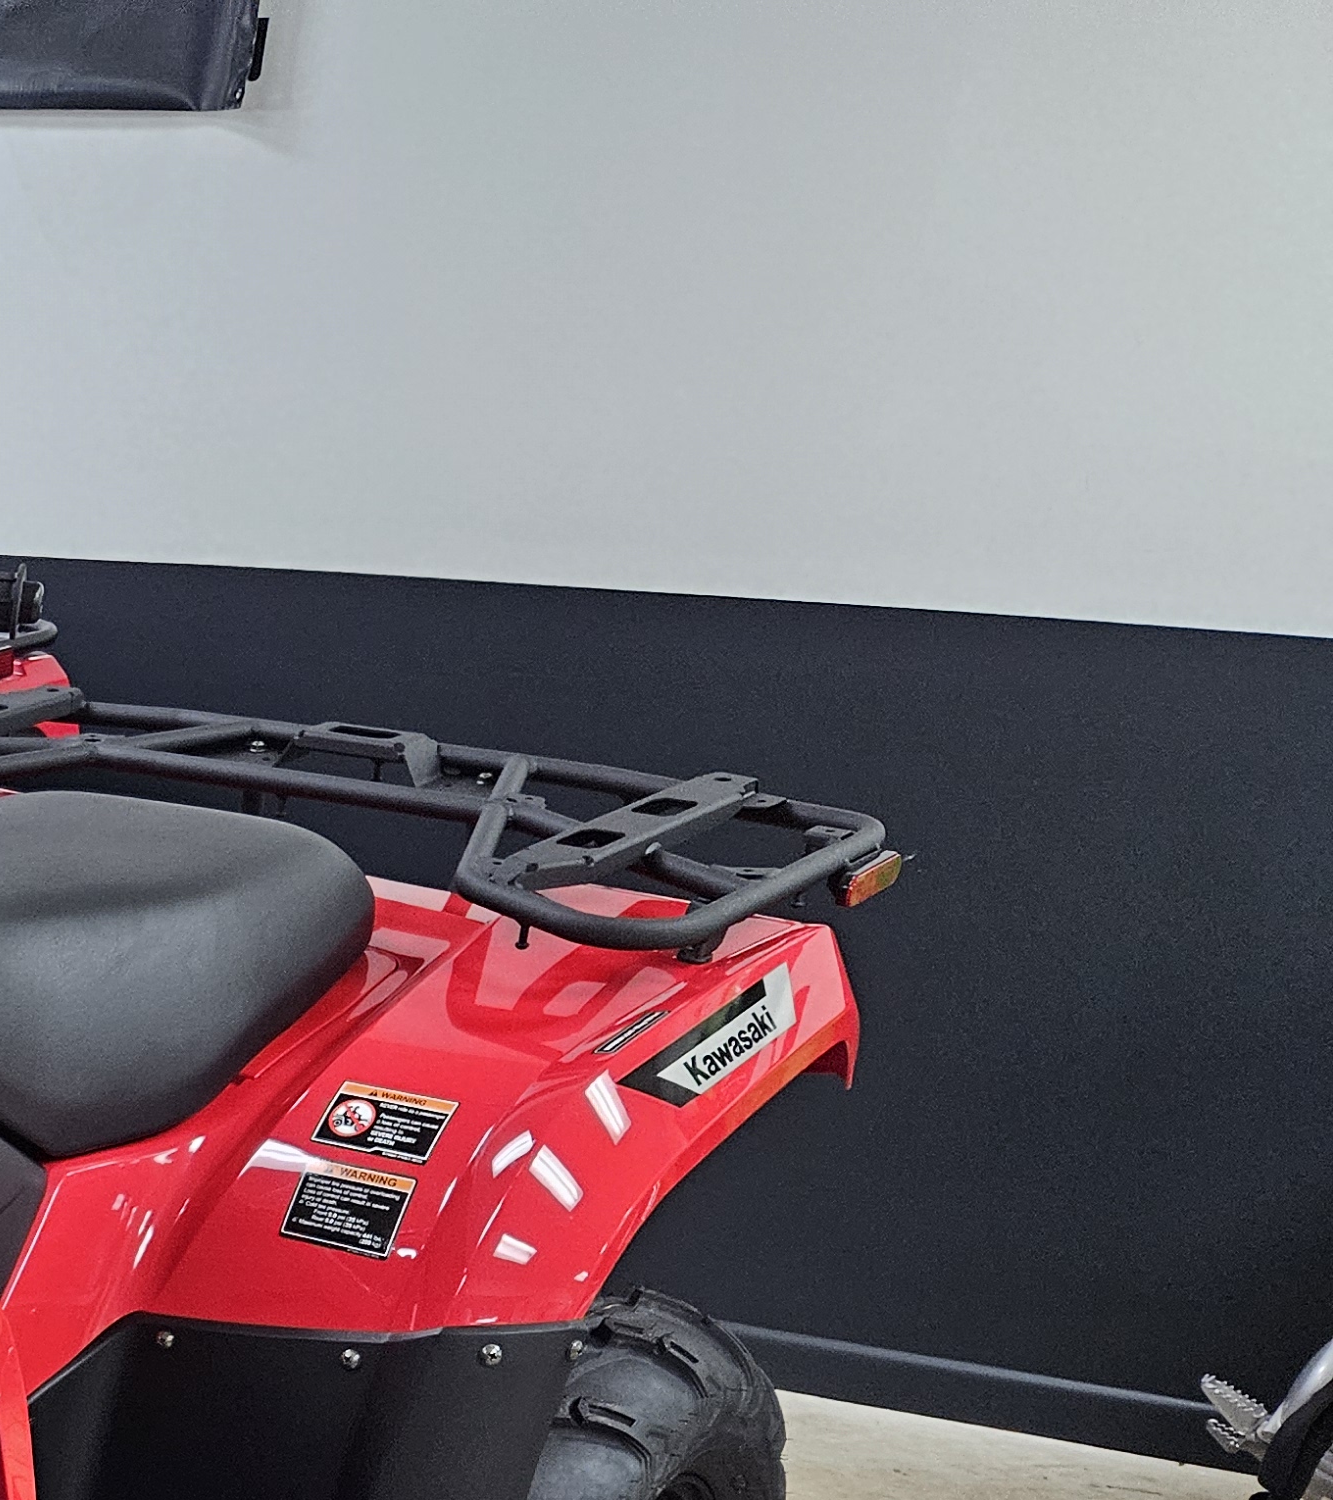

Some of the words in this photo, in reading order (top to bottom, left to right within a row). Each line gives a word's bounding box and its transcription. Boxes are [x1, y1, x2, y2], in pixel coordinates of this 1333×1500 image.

[683, 1005, 777, 1087] Kawasaki
[381, 1091, 427, 1107] WARNING
[340, 1168, 398, 1187] WARNING
